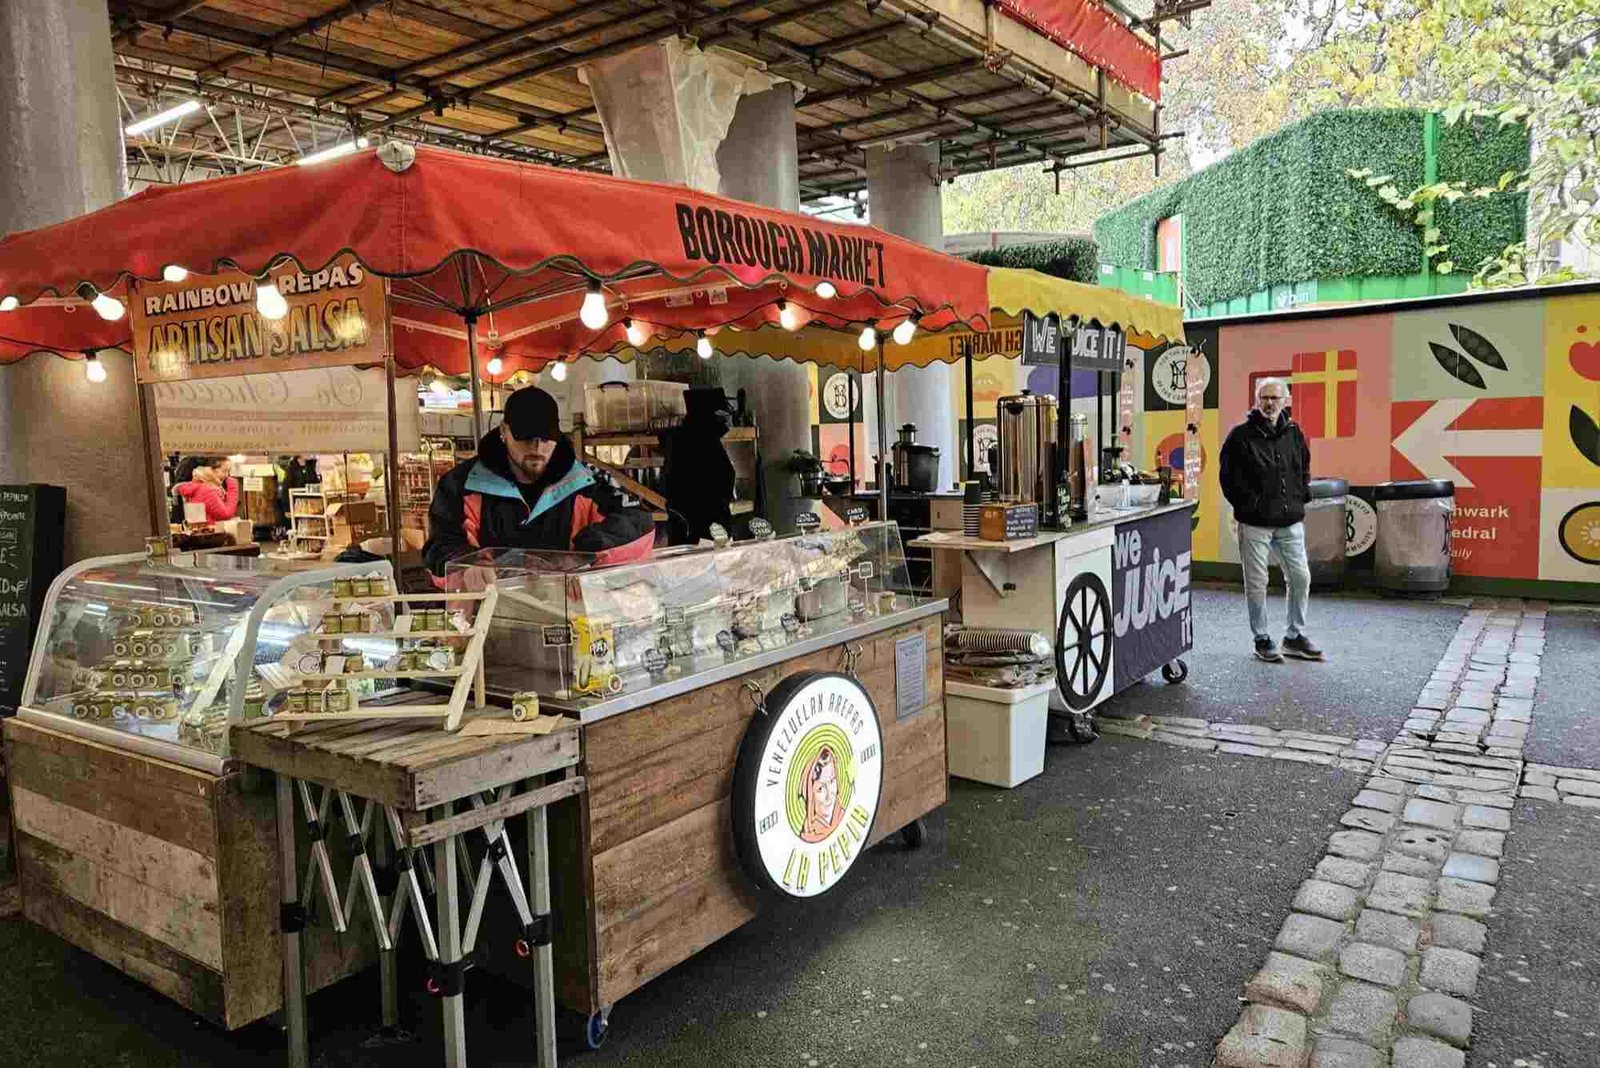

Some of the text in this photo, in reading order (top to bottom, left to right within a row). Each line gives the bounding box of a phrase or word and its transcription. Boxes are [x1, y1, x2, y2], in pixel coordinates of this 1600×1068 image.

[675, 203, 885, 289] BOROUGH MARKET
[146, 261, 364, 316] RAINBOW REPAS
[149, 297, 367, 369] ARTISAN SALSA
[1031, 317, 1057, 354] WE
[1102, 328, 1122, 360] IT!
[1115, 529, 1142, 570] we
[1451, 548, 1472, 560] aily
[766, 691, 865, 788] VENEZUELAN AREPAS
[782, 848, 811, 890] LA
